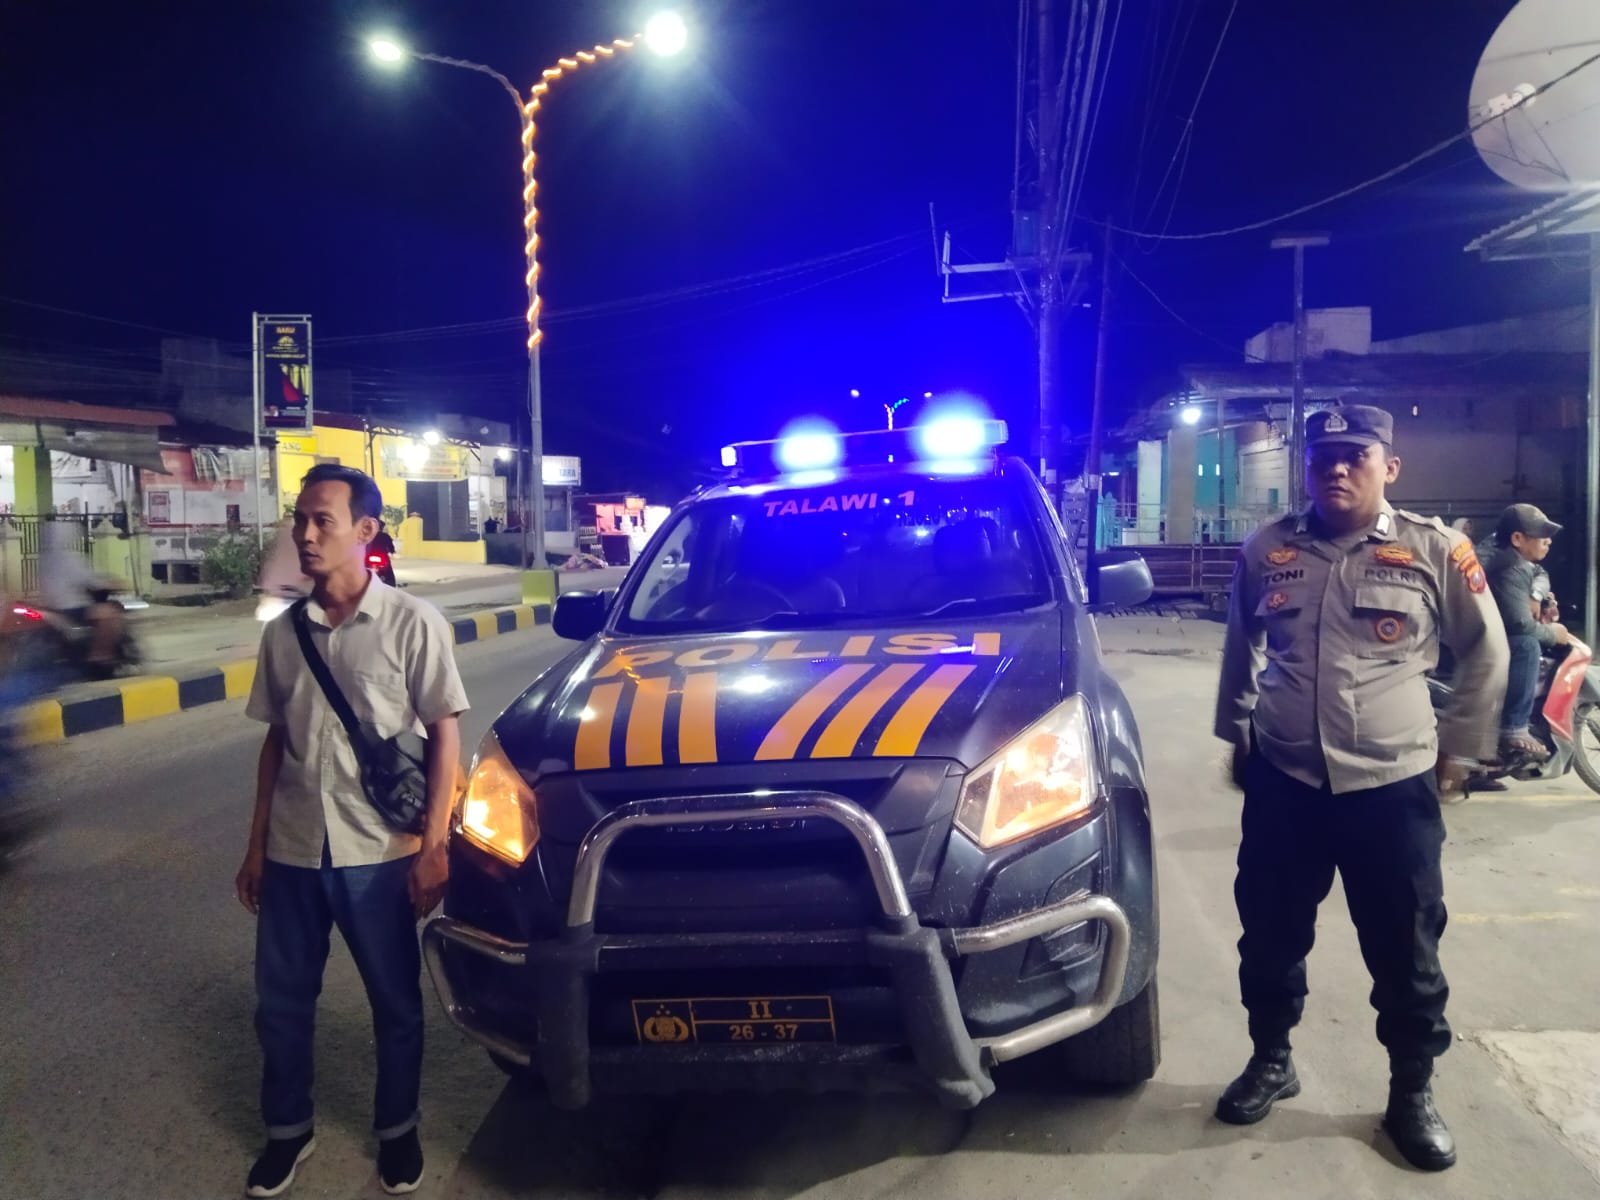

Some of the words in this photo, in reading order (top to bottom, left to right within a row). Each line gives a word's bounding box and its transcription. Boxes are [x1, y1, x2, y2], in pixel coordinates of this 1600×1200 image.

[763, 492, 878, 518] TALAWI
[897, 490, 915, 507] 1
[1264, 569, 1304, 585] TONI
[1364, 568, 1417, 583] POLRI
[591, 632, 1001, 679] POLISI
[749, 1001, 773, 1018] II
[729, 1024, 754, 1040] 26
[774, 1023, 798, 1040] 37
